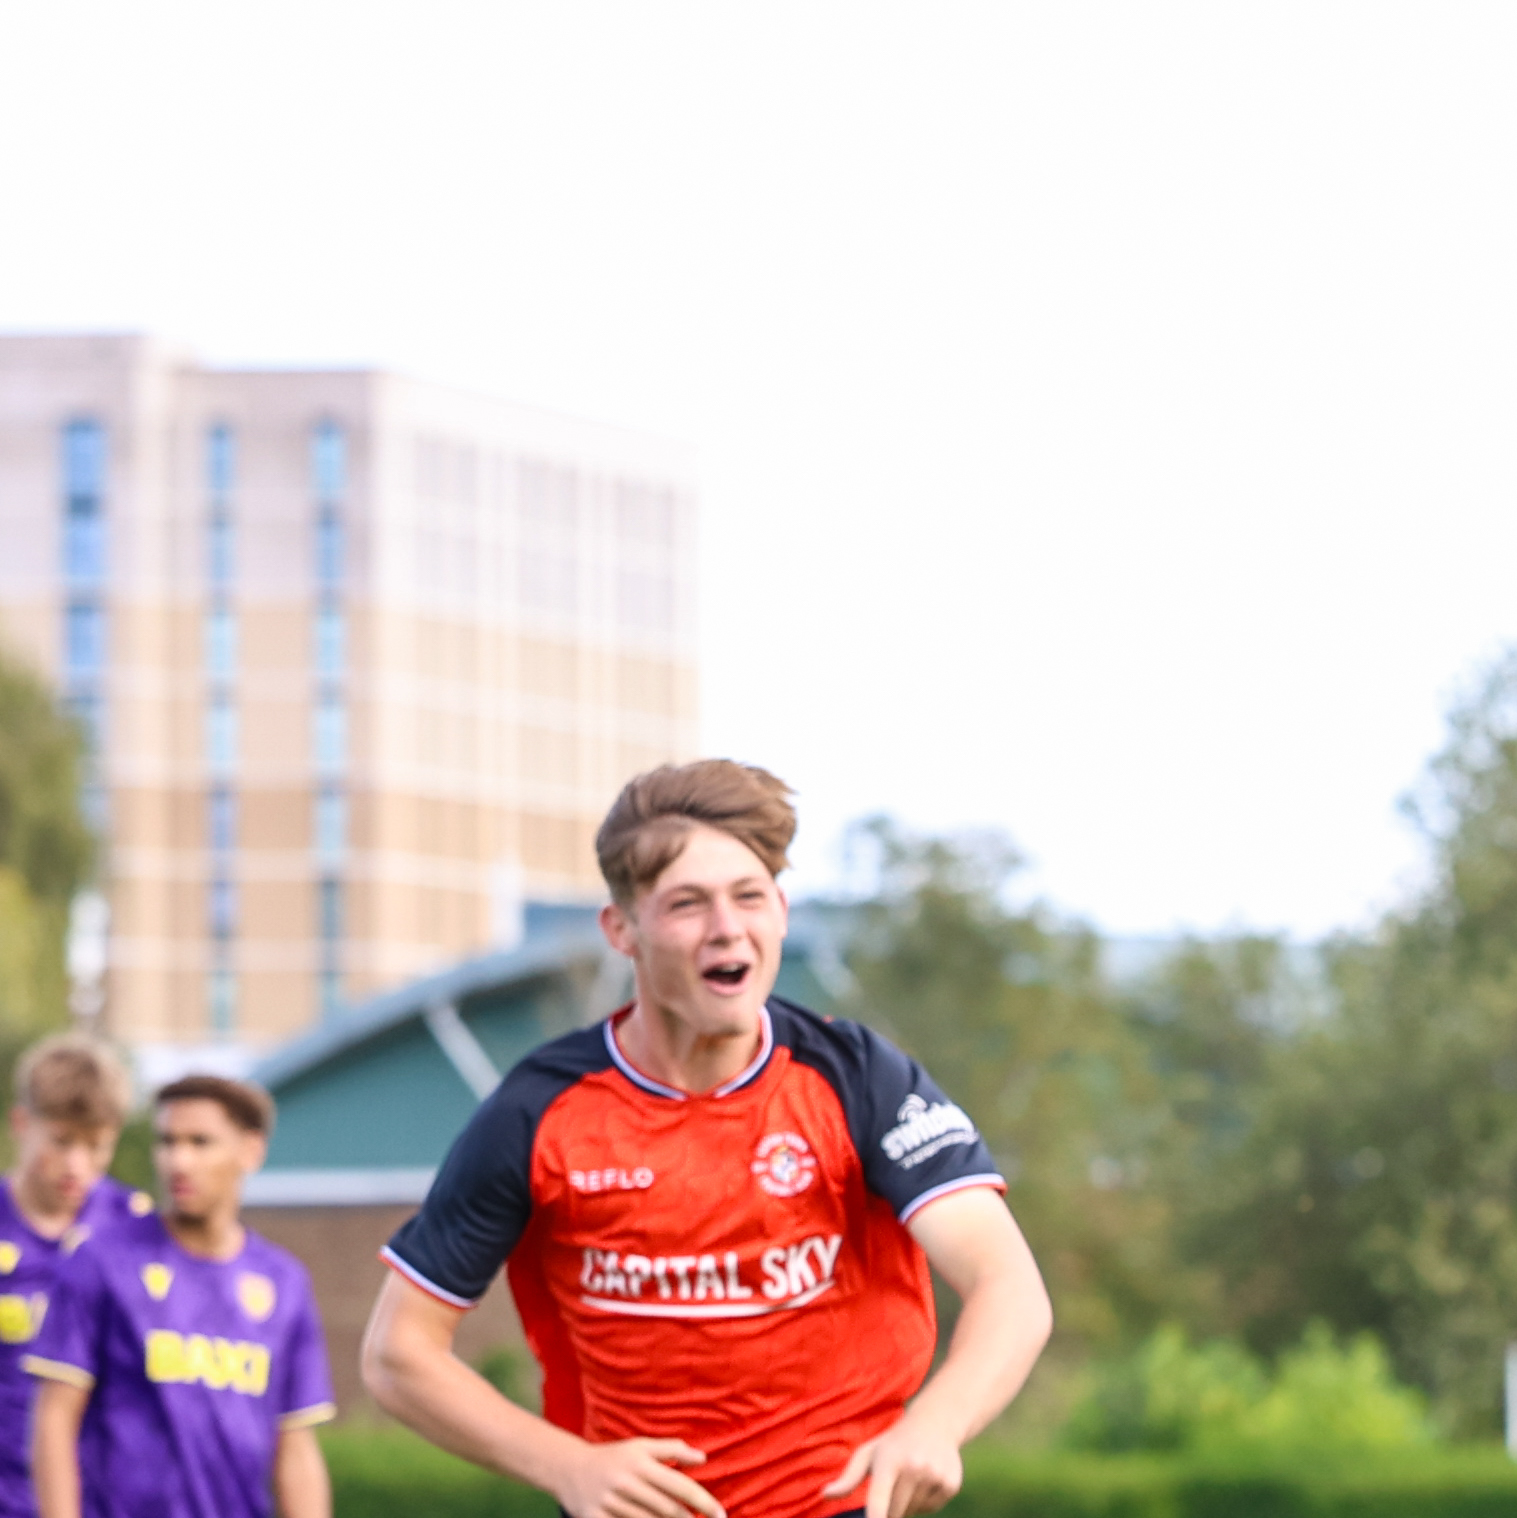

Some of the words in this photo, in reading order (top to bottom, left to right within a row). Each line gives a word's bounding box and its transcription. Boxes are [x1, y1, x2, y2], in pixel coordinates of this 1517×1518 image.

[568, 1166, 655, 1193] REFLO
[580, 1247, 752, 1300] CAPITAL
[761, 1234, 843, 1299] SKY
